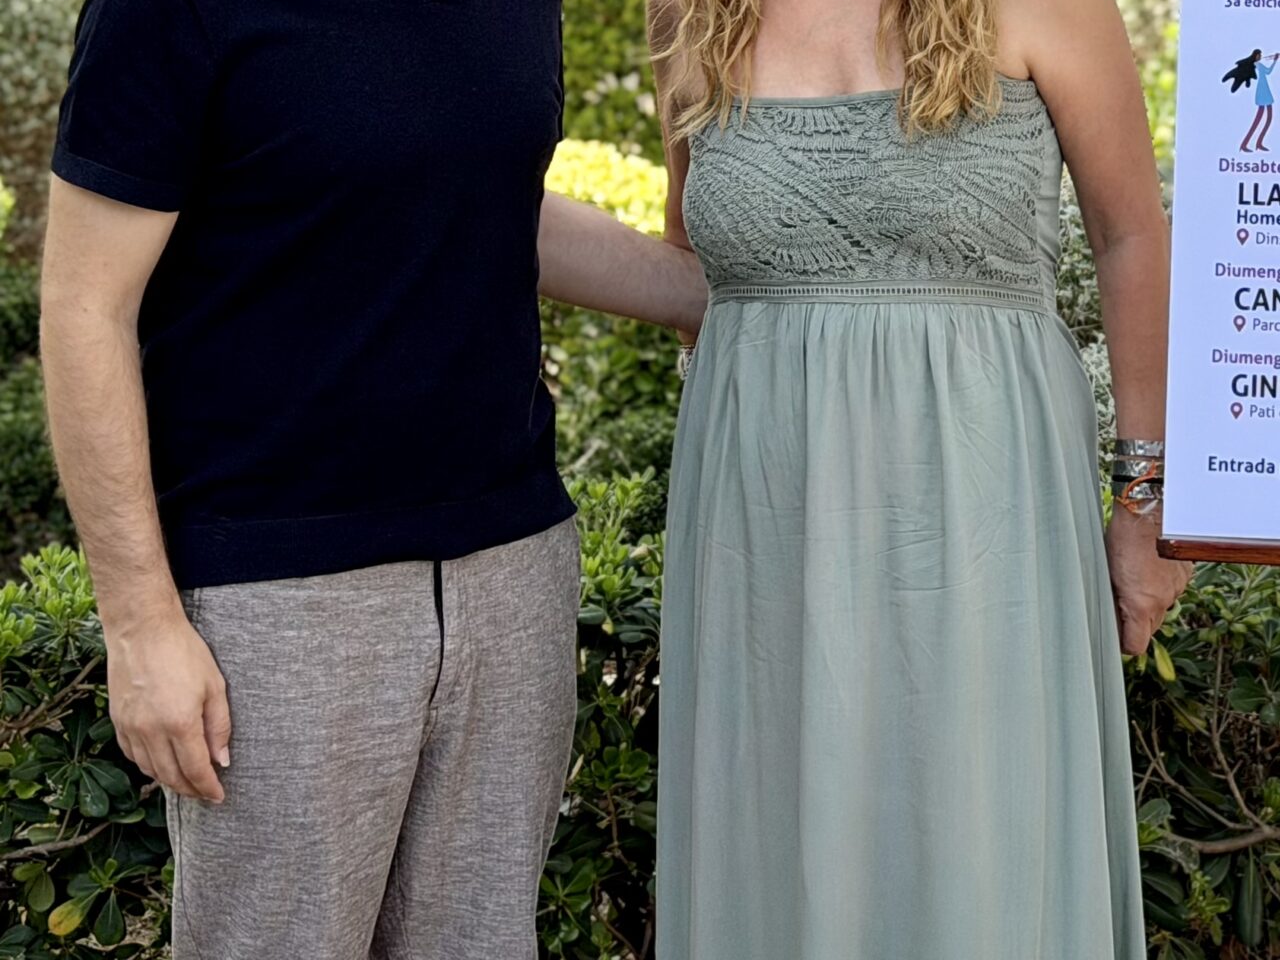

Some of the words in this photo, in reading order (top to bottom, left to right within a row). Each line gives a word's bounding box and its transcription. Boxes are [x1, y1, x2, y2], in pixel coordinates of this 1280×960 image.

[1253, 318, 1280, 332] Parc
[1250, 404, 1275, 418] Pati
[1208, 456, 1275, 474] Entrada
